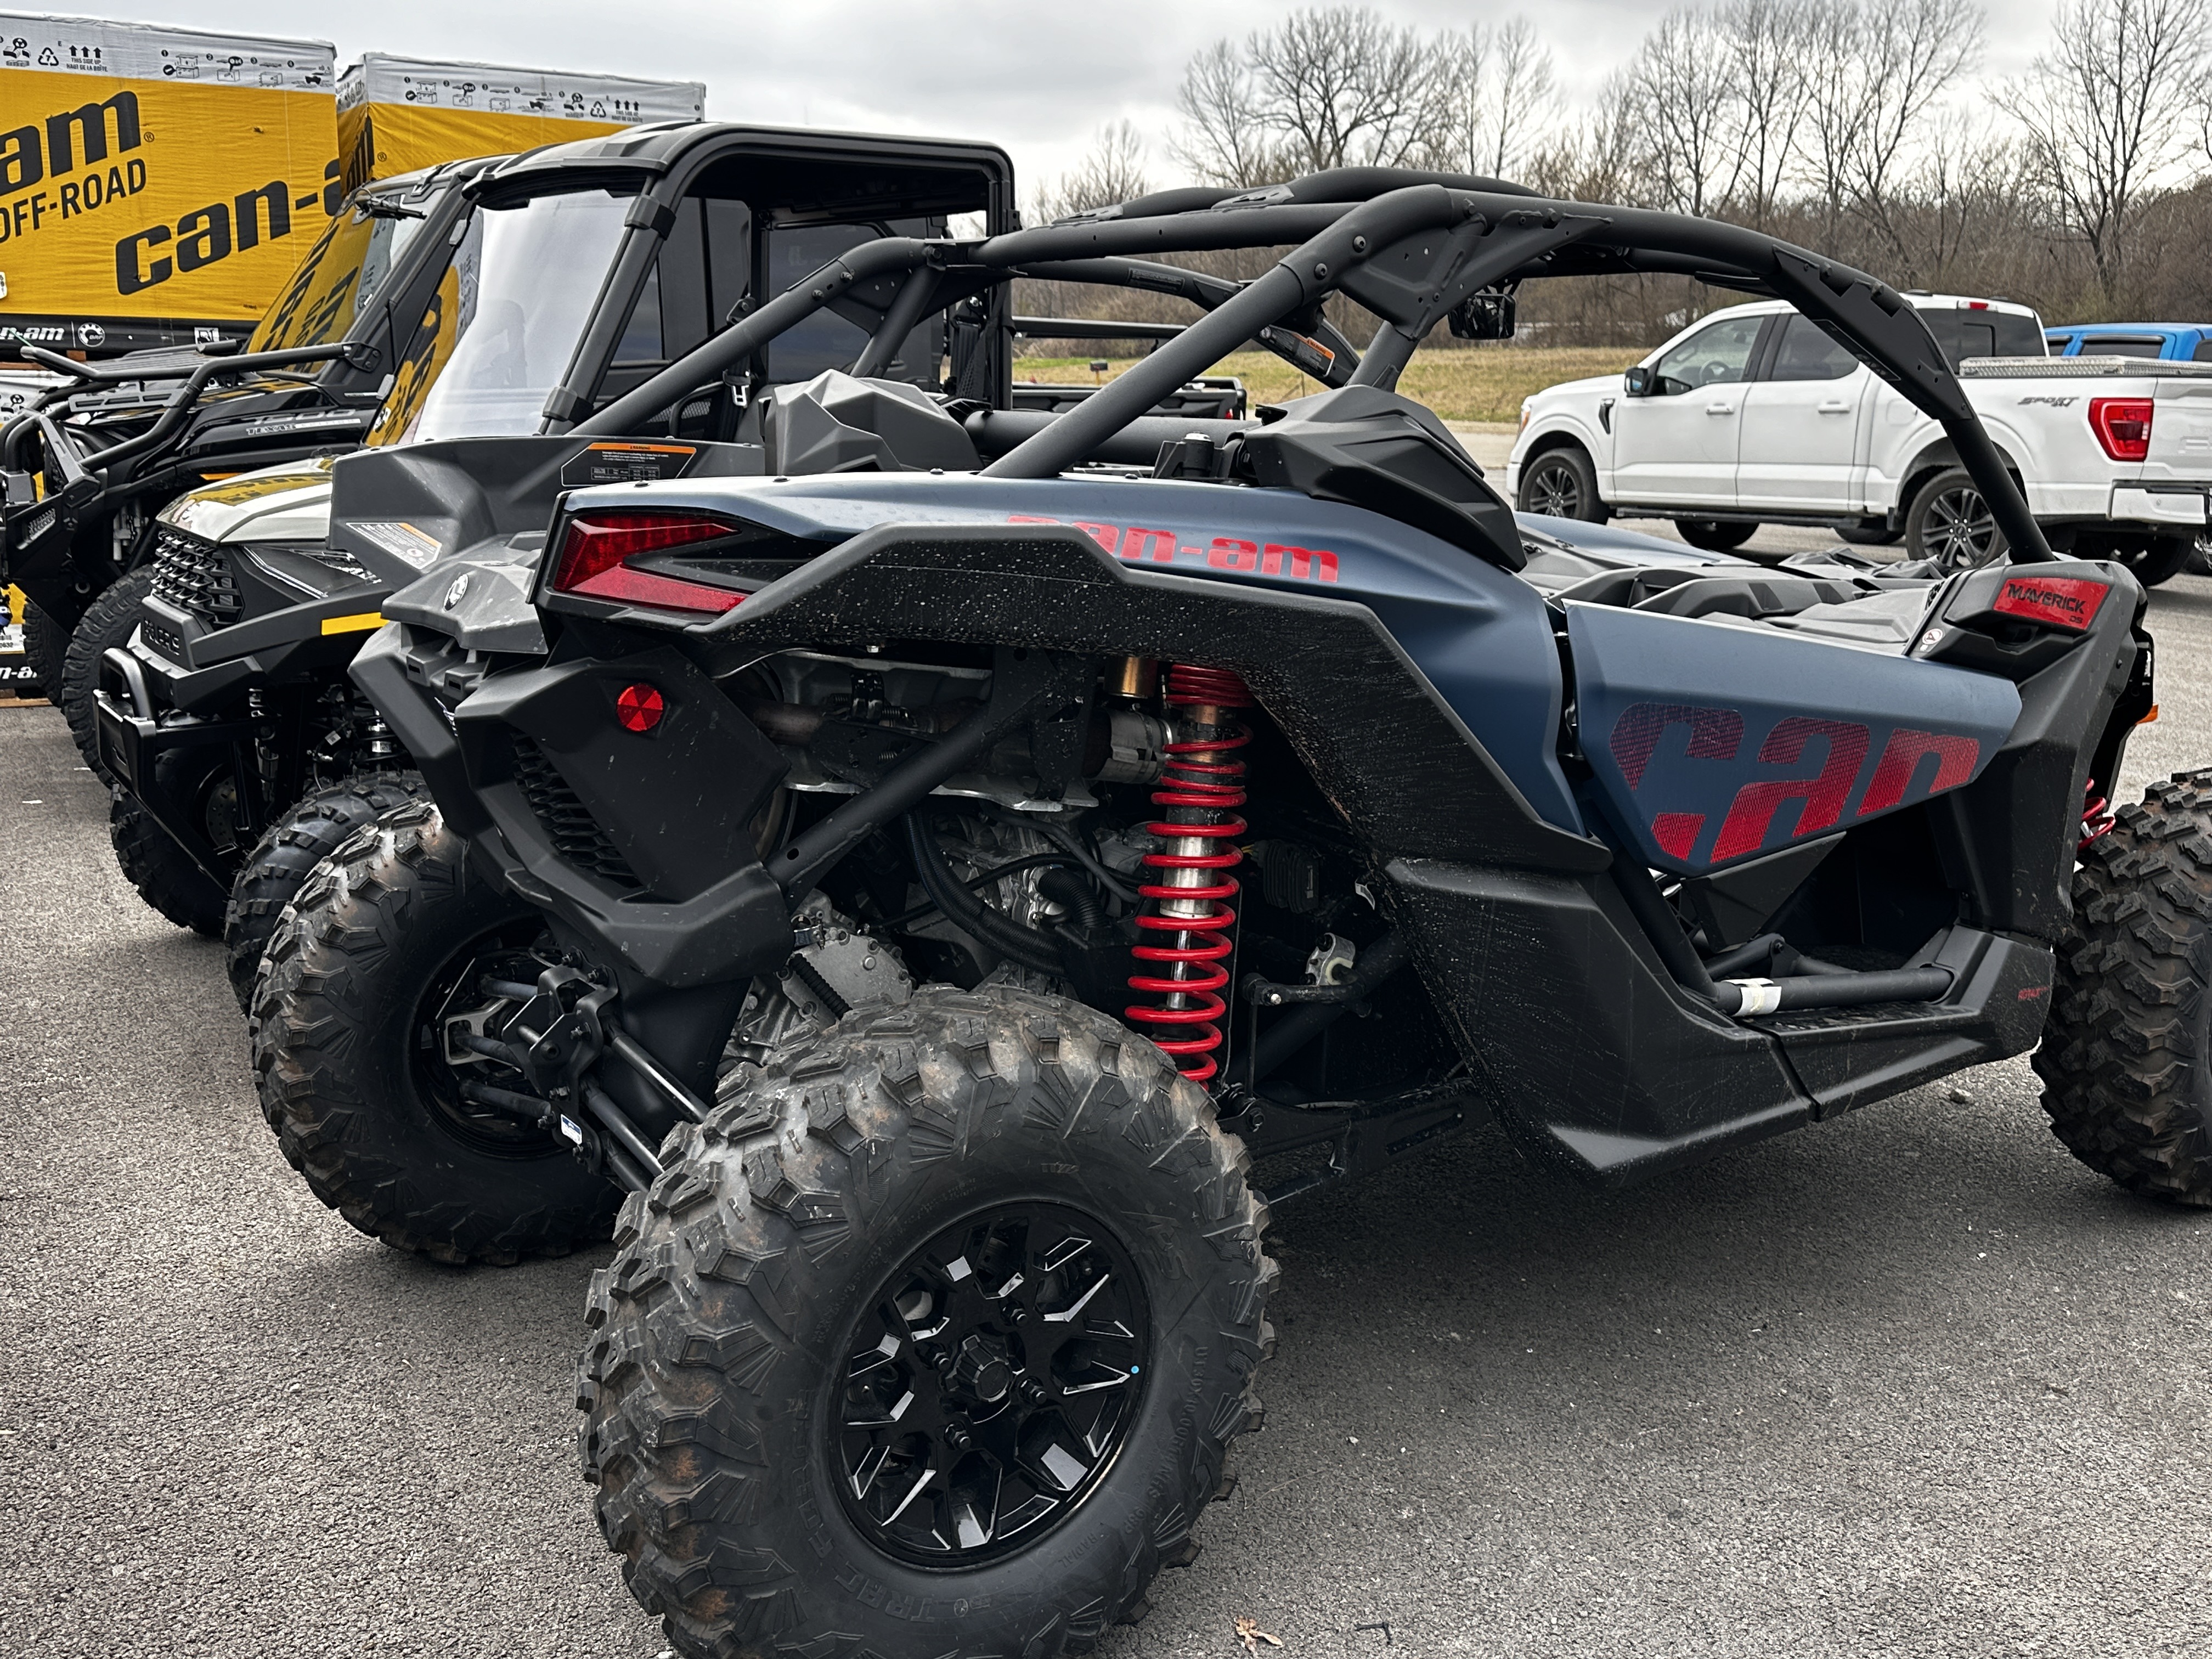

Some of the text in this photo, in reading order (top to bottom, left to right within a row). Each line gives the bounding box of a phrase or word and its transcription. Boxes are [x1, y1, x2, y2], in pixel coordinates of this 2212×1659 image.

[246, 424, 296, 435] TEXAS
[1008, 516, 1338, 583] an-am
[2007, 583, 2086, 614] MAVERICK
[143, 617, 180, 656] POLARIS
[2069, 615, 2084, 624] DS
[0, 667, 37, 679] n-a
[1610, 702, 1980, 865] can
[1057, 1532, 1098, 1570] RADIAL
[833, 1560, 935, 1623] TRAC
